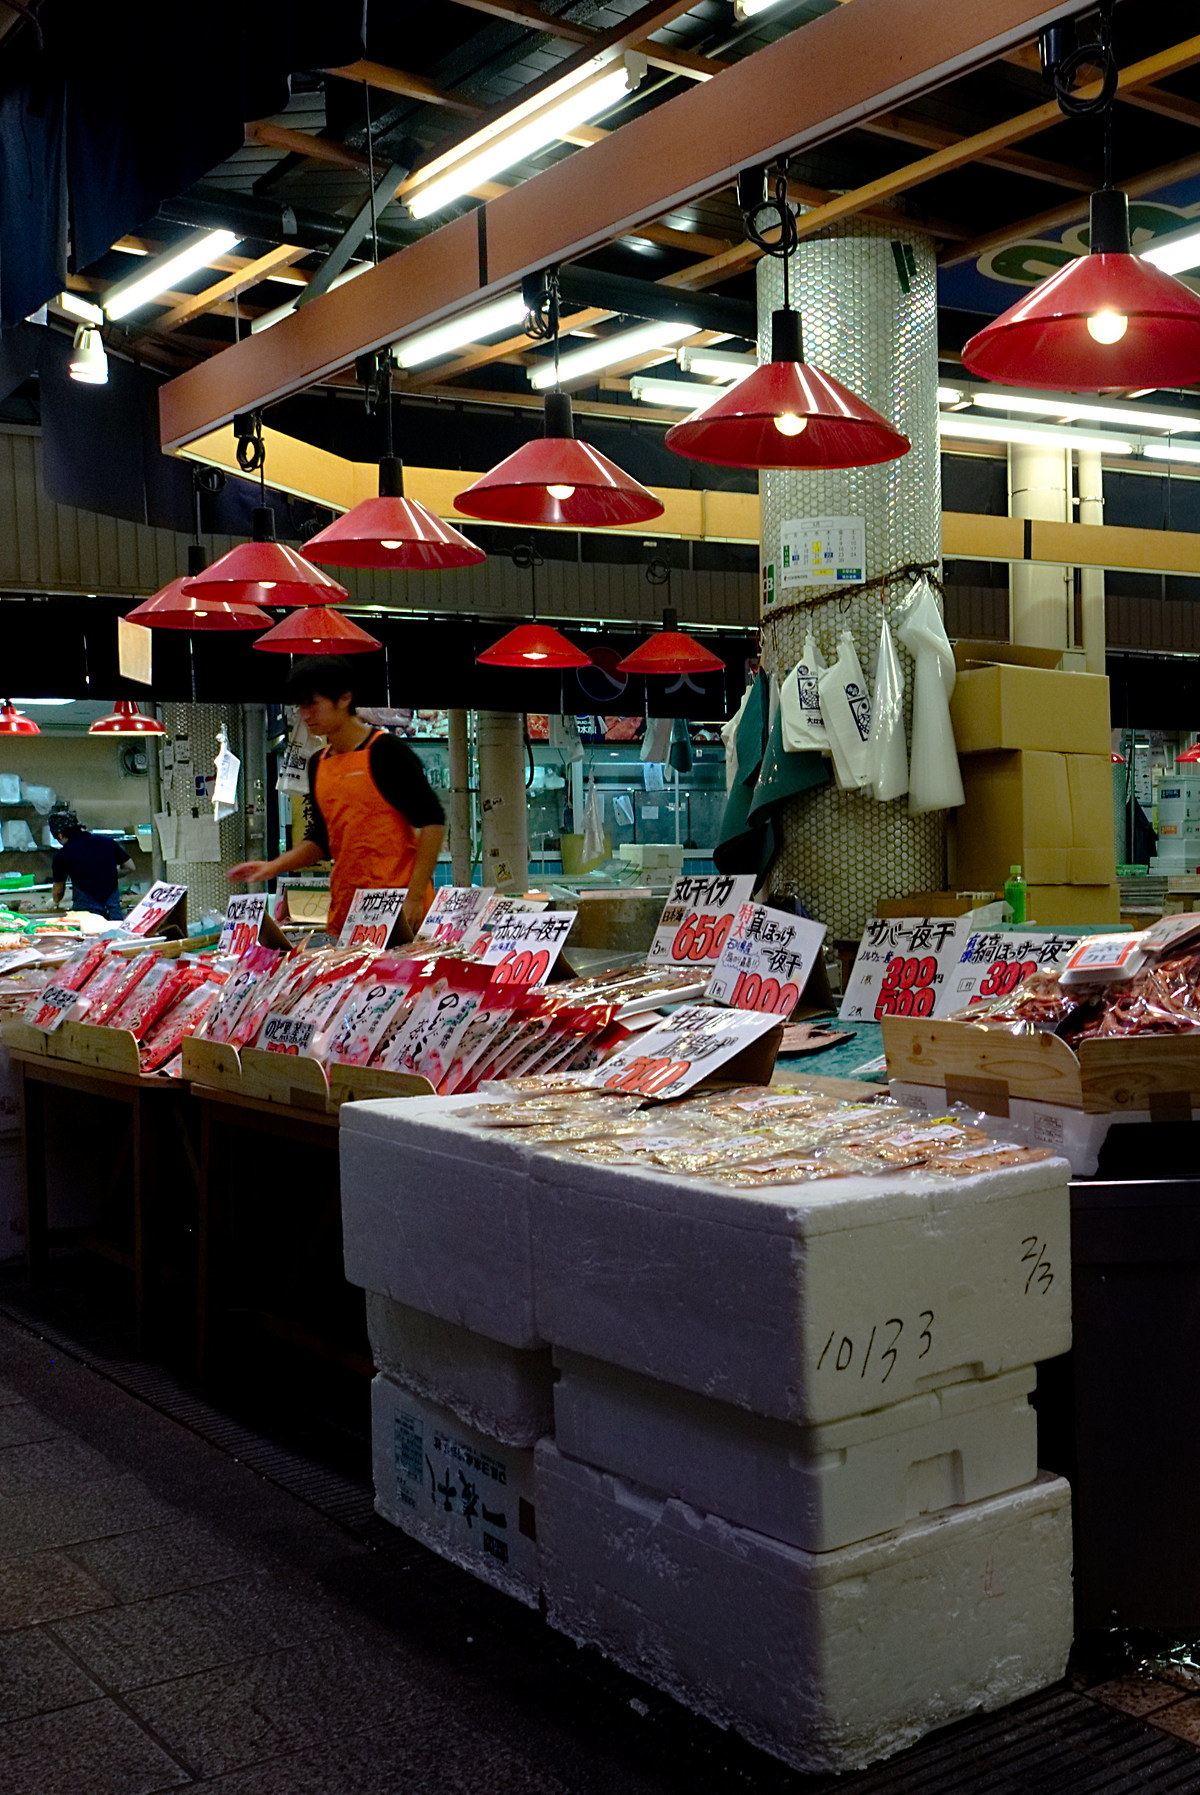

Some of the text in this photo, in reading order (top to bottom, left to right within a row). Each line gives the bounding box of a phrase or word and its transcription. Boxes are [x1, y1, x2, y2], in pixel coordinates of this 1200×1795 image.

[669, 876, 737, 908] 丸干イカ
[672, 912, 735, 961] 650
[747, 908, 797, 947] 真ほっけ
[490, 949, 550, 985] 600
[729, 971, 799, 1017] 1000
[874, 987, 936, 1020] 500
[1020, 1236, 1054, 1295] 2/3
